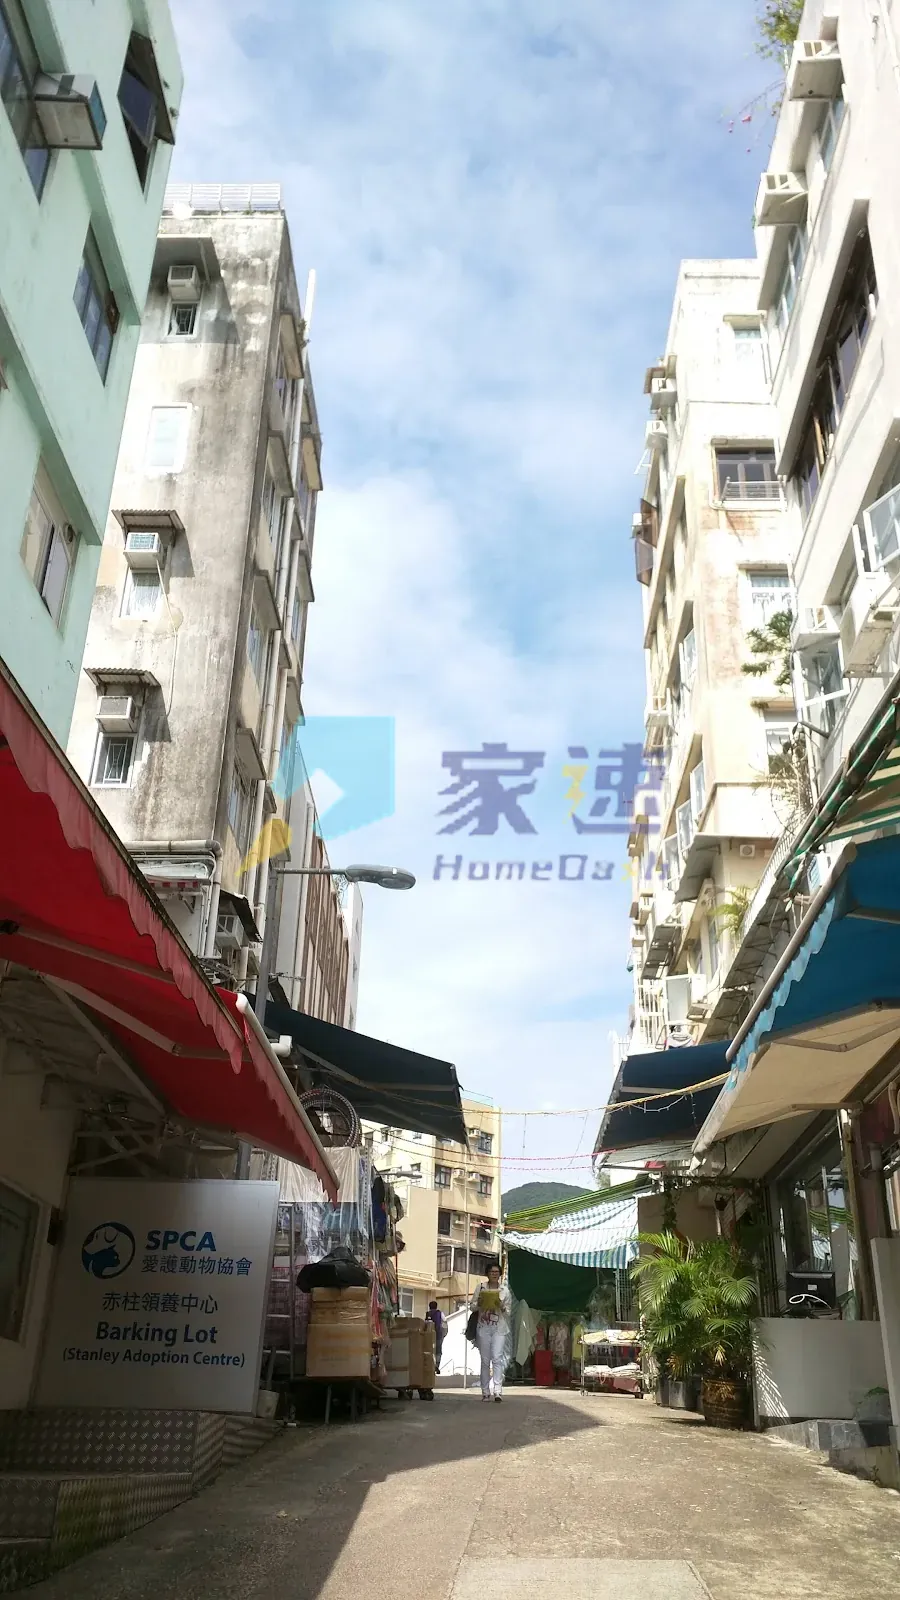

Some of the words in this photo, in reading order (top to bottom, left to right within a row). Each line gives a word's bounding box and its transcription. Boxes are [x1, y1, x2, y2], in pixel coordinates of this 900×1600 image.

[145, 1230, 217, 1252] SPCA
[141, 1254, 253, 1276] 愛護動物協會
[102, 1292, 218, 1315] 赤柱領養中心
[96, 1321, 178, 1347] Barking
[184, 1324, 218, 1344] Lot
[63, 1347, 119, 1365] (Stanley
[122, 1349, 189, 1367] Adoption
[193, 1352, 246, 1368] Centre)
